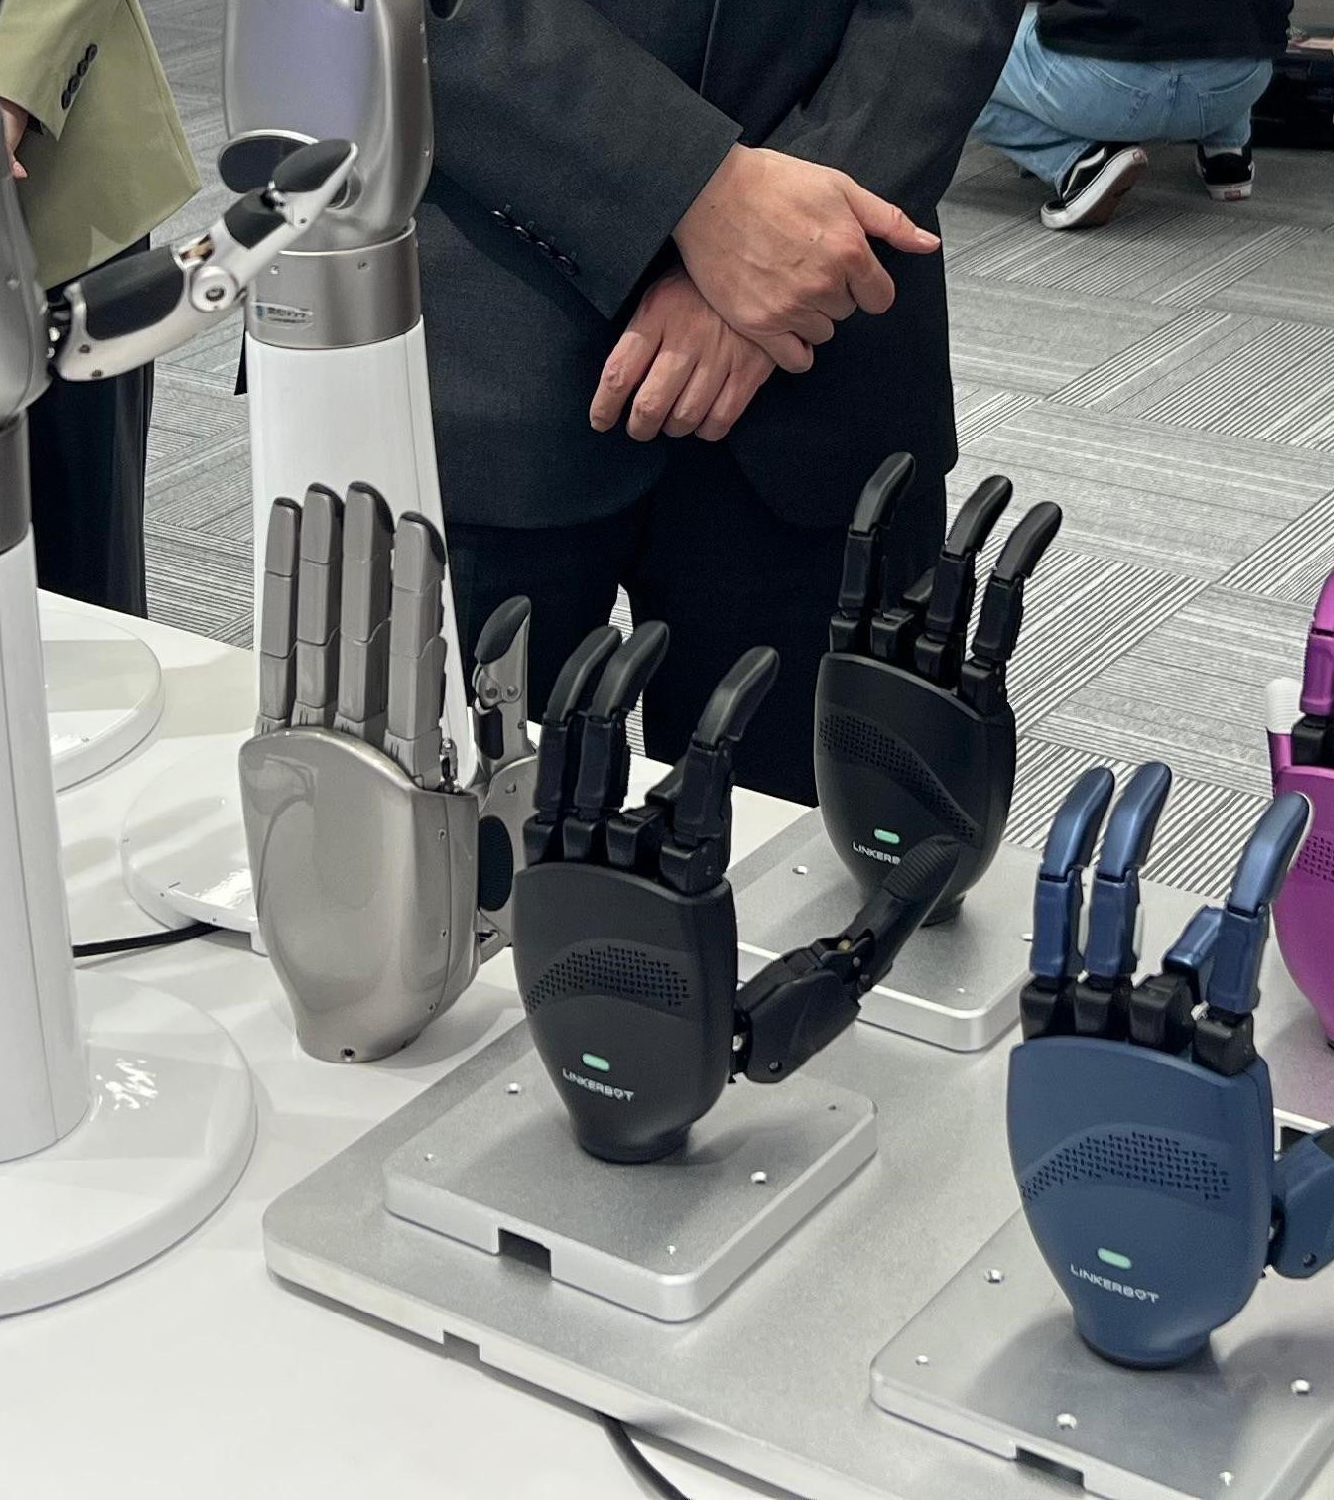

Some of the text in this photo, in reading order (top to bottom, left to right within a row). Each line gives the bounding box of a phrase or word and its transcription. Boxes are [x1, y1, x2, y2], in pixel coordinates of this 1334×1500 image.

[852, 840, 901, 866] LINKERB
[561, 1067, 635, 1103] LINKERBOT
[1069, 1262, 1160, 1304] LINKERBOT
